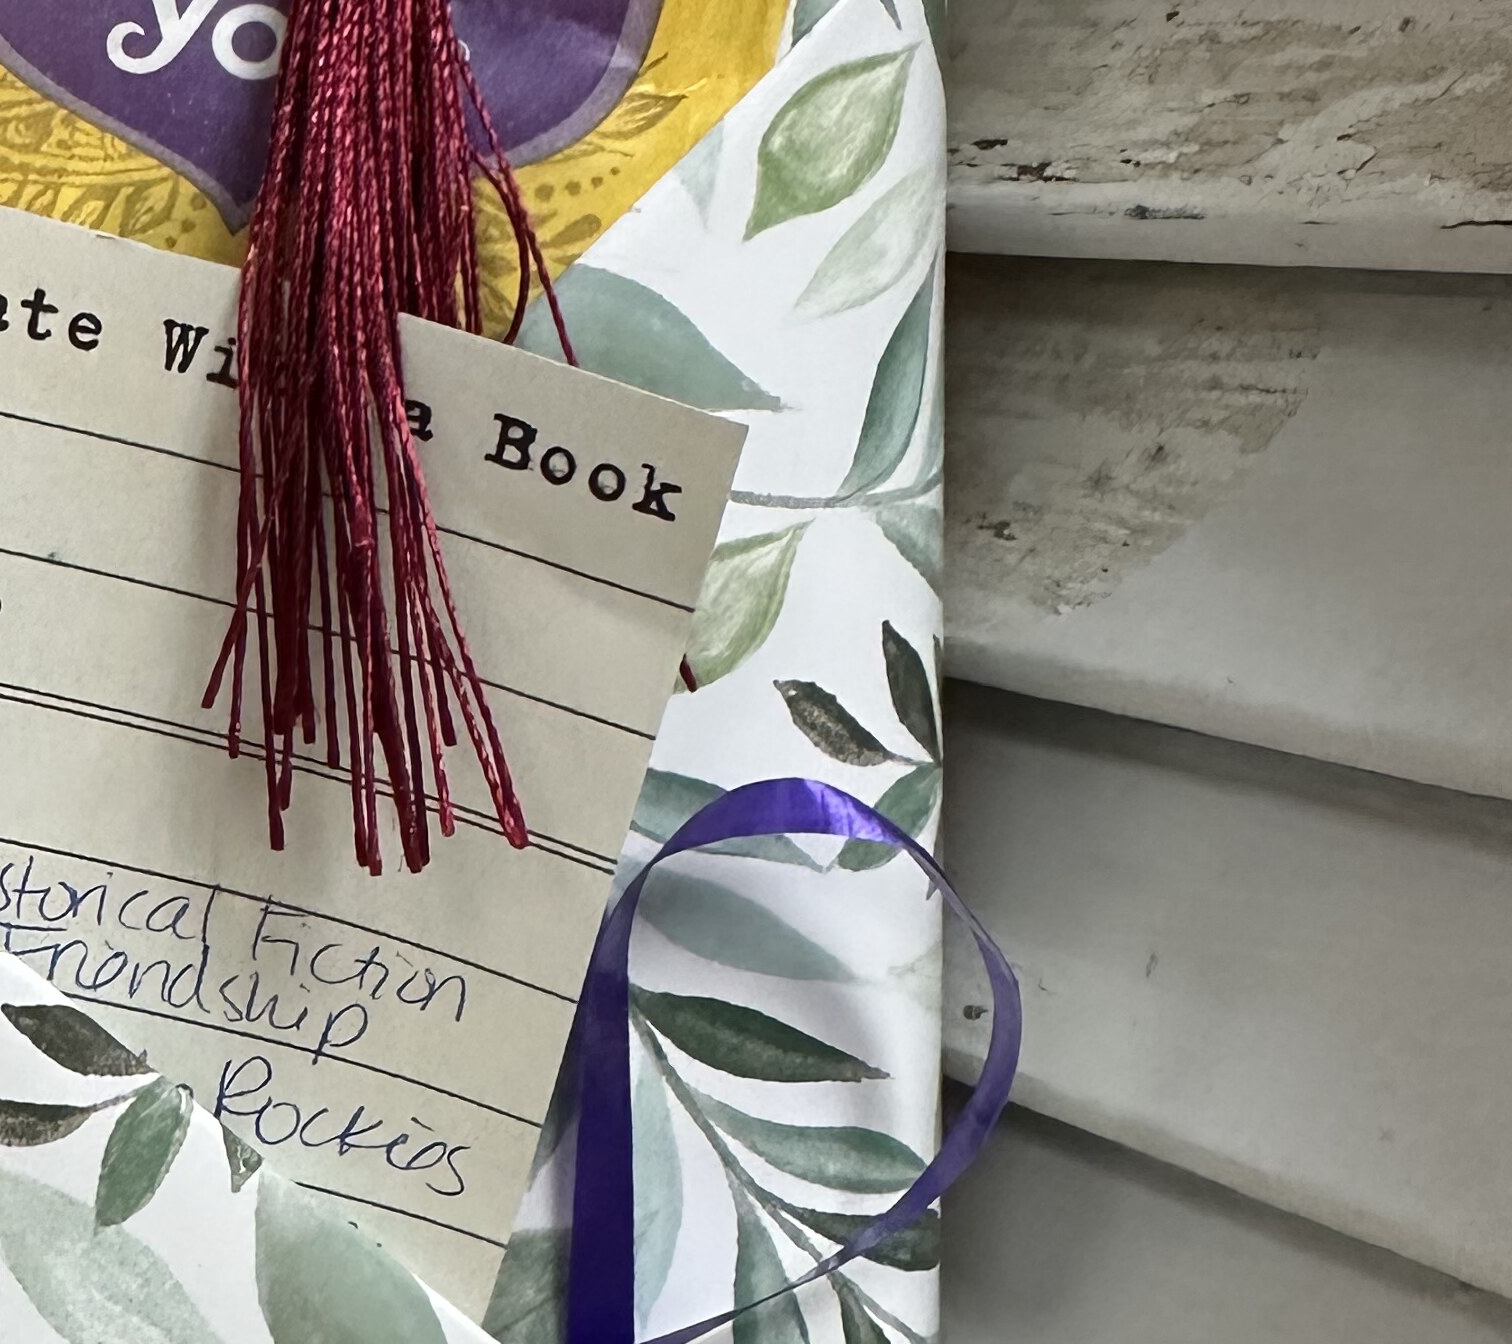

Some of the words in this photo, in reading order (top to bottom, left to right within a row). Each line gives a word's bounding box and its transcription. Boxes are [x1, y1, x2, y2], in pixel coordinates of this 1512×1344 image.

[162, 317, 238, 391] Wi
[484, 412, 683, 523] Book
[252, 894, 467, 1023] Fiction
[214, 1055, 473, 1197] Rockies
